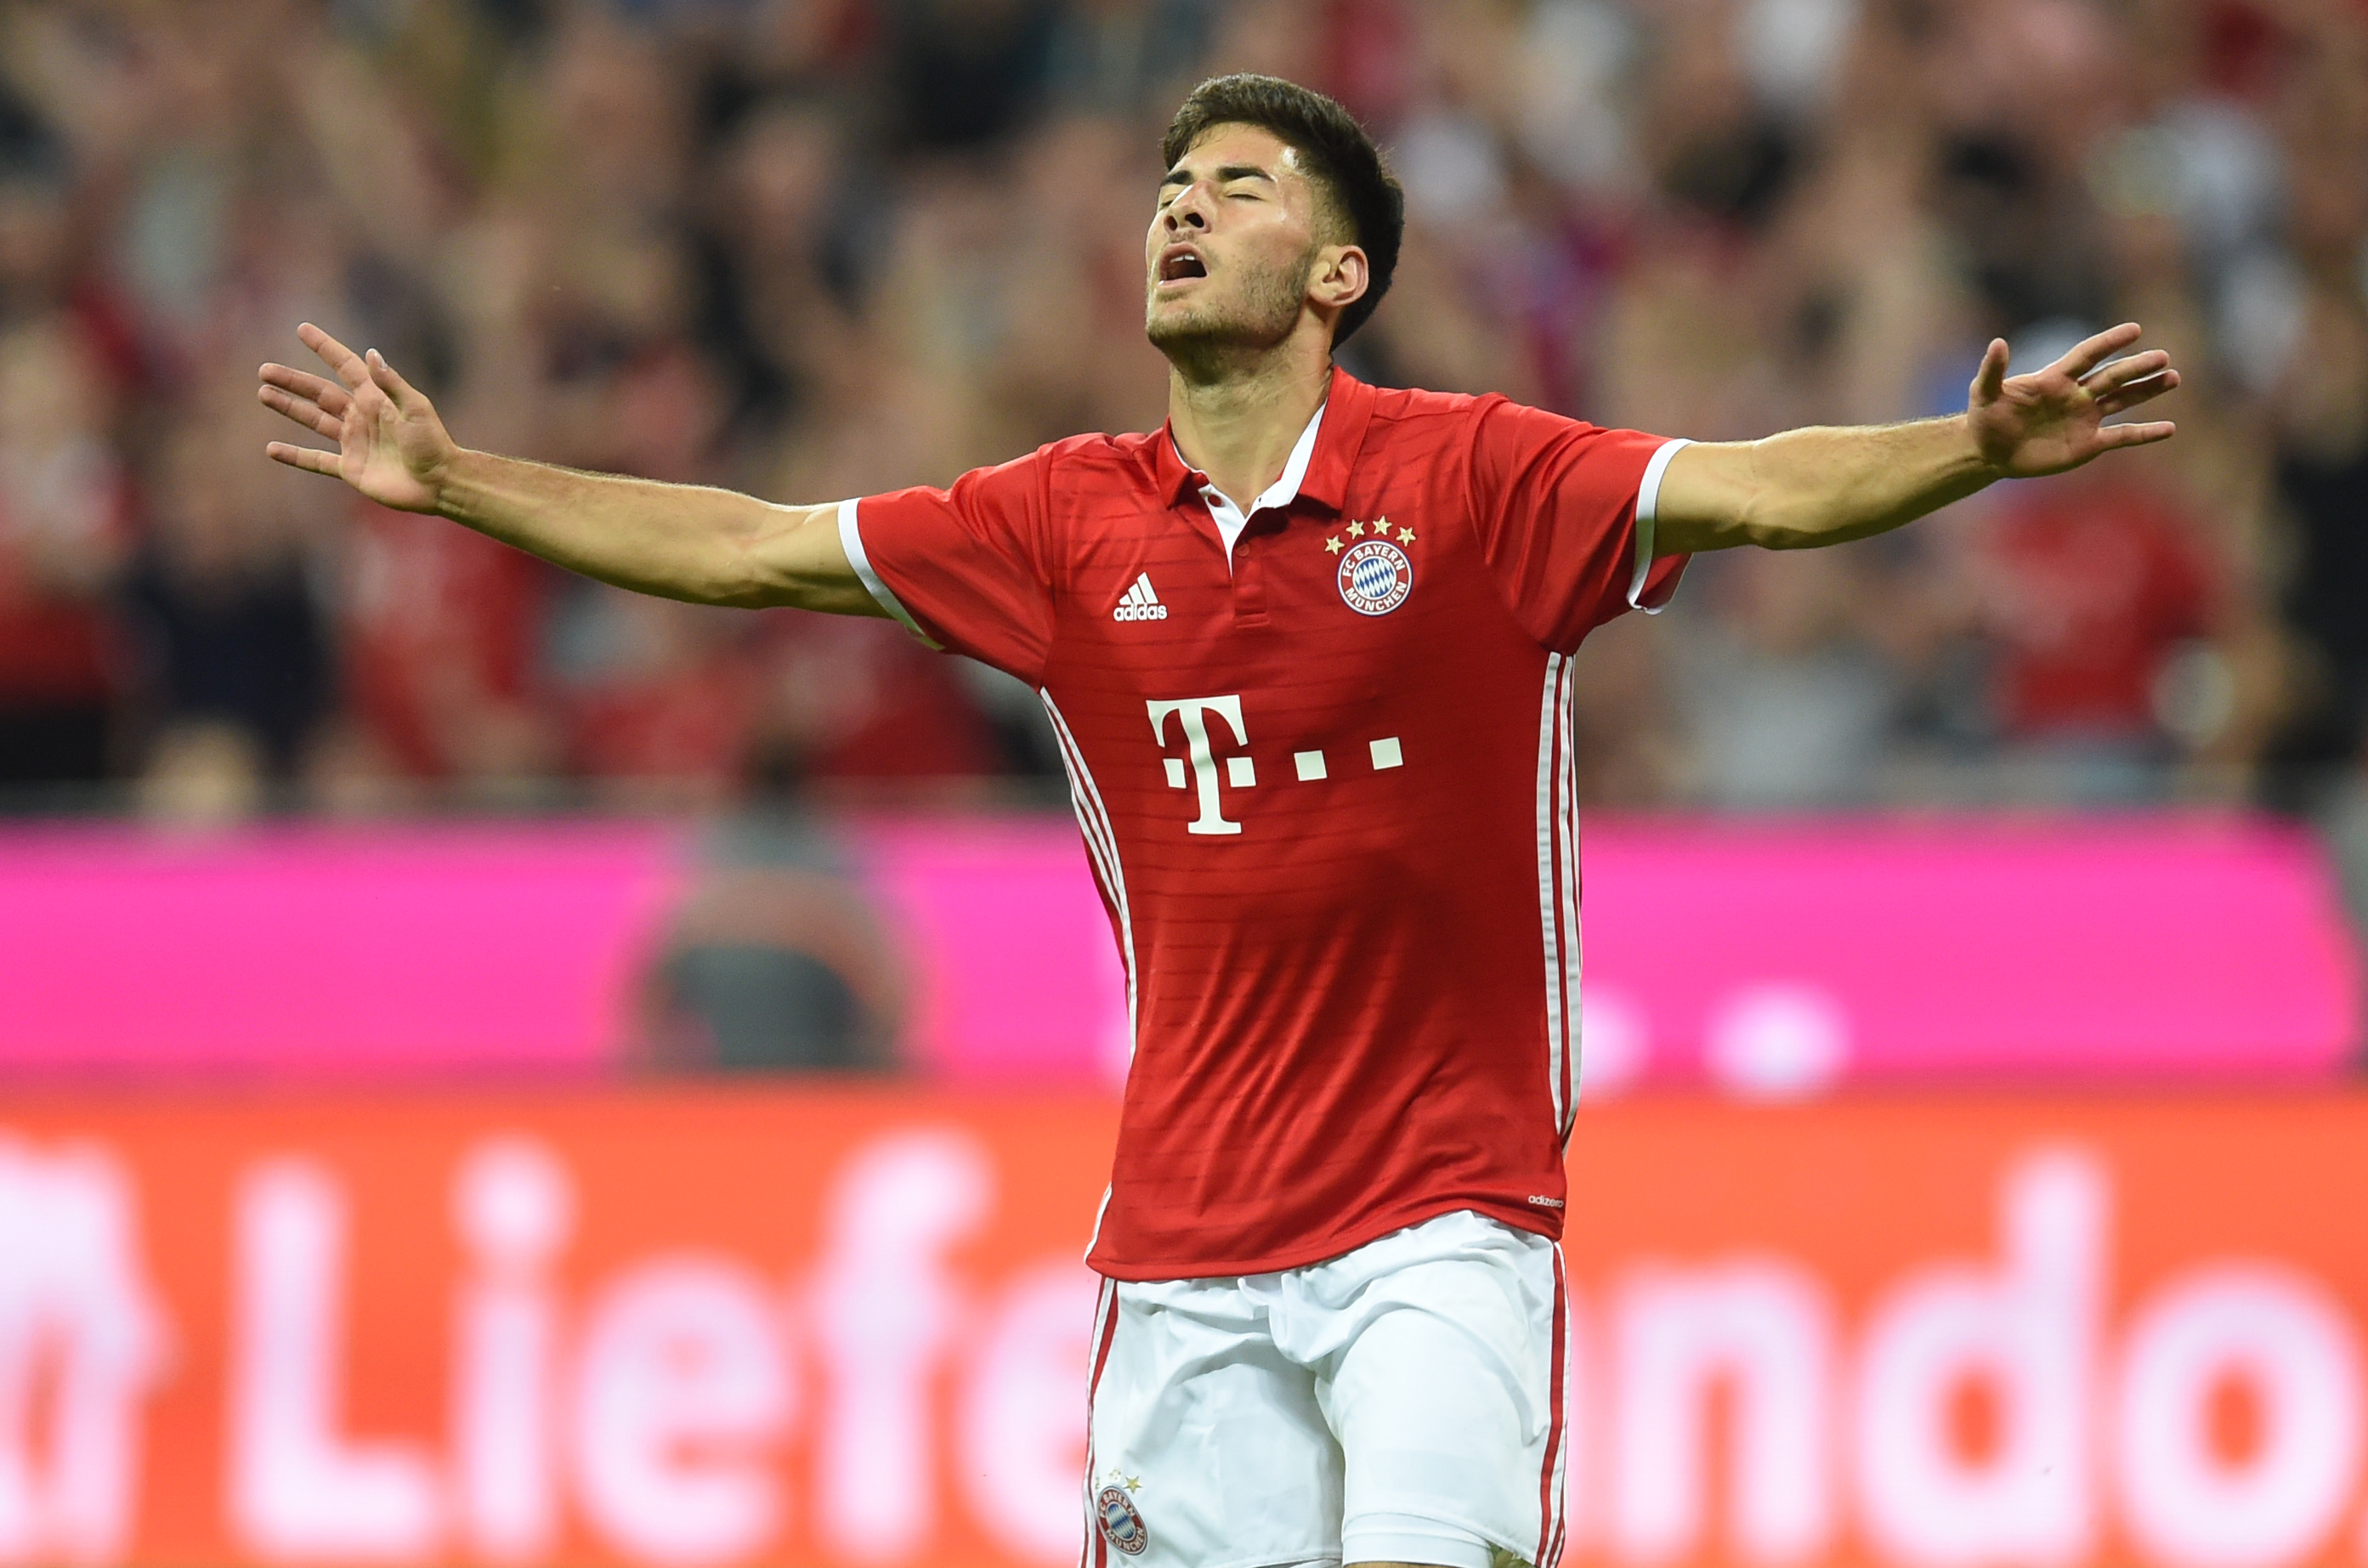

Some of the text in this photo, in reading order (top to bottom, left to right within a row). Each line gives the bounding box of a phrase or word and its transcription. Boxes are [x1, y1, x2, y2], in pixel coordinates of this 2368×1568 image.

[1343, 545, 1406, 577] FC BAYERN
[1113, 602, 1167, 621] adidas
[1528, 1195, 1563, 1208] adizero
[231, 1130, 2359, 1565] Liefendo
[1103, 1491, 1135, 1517] BAYERN
